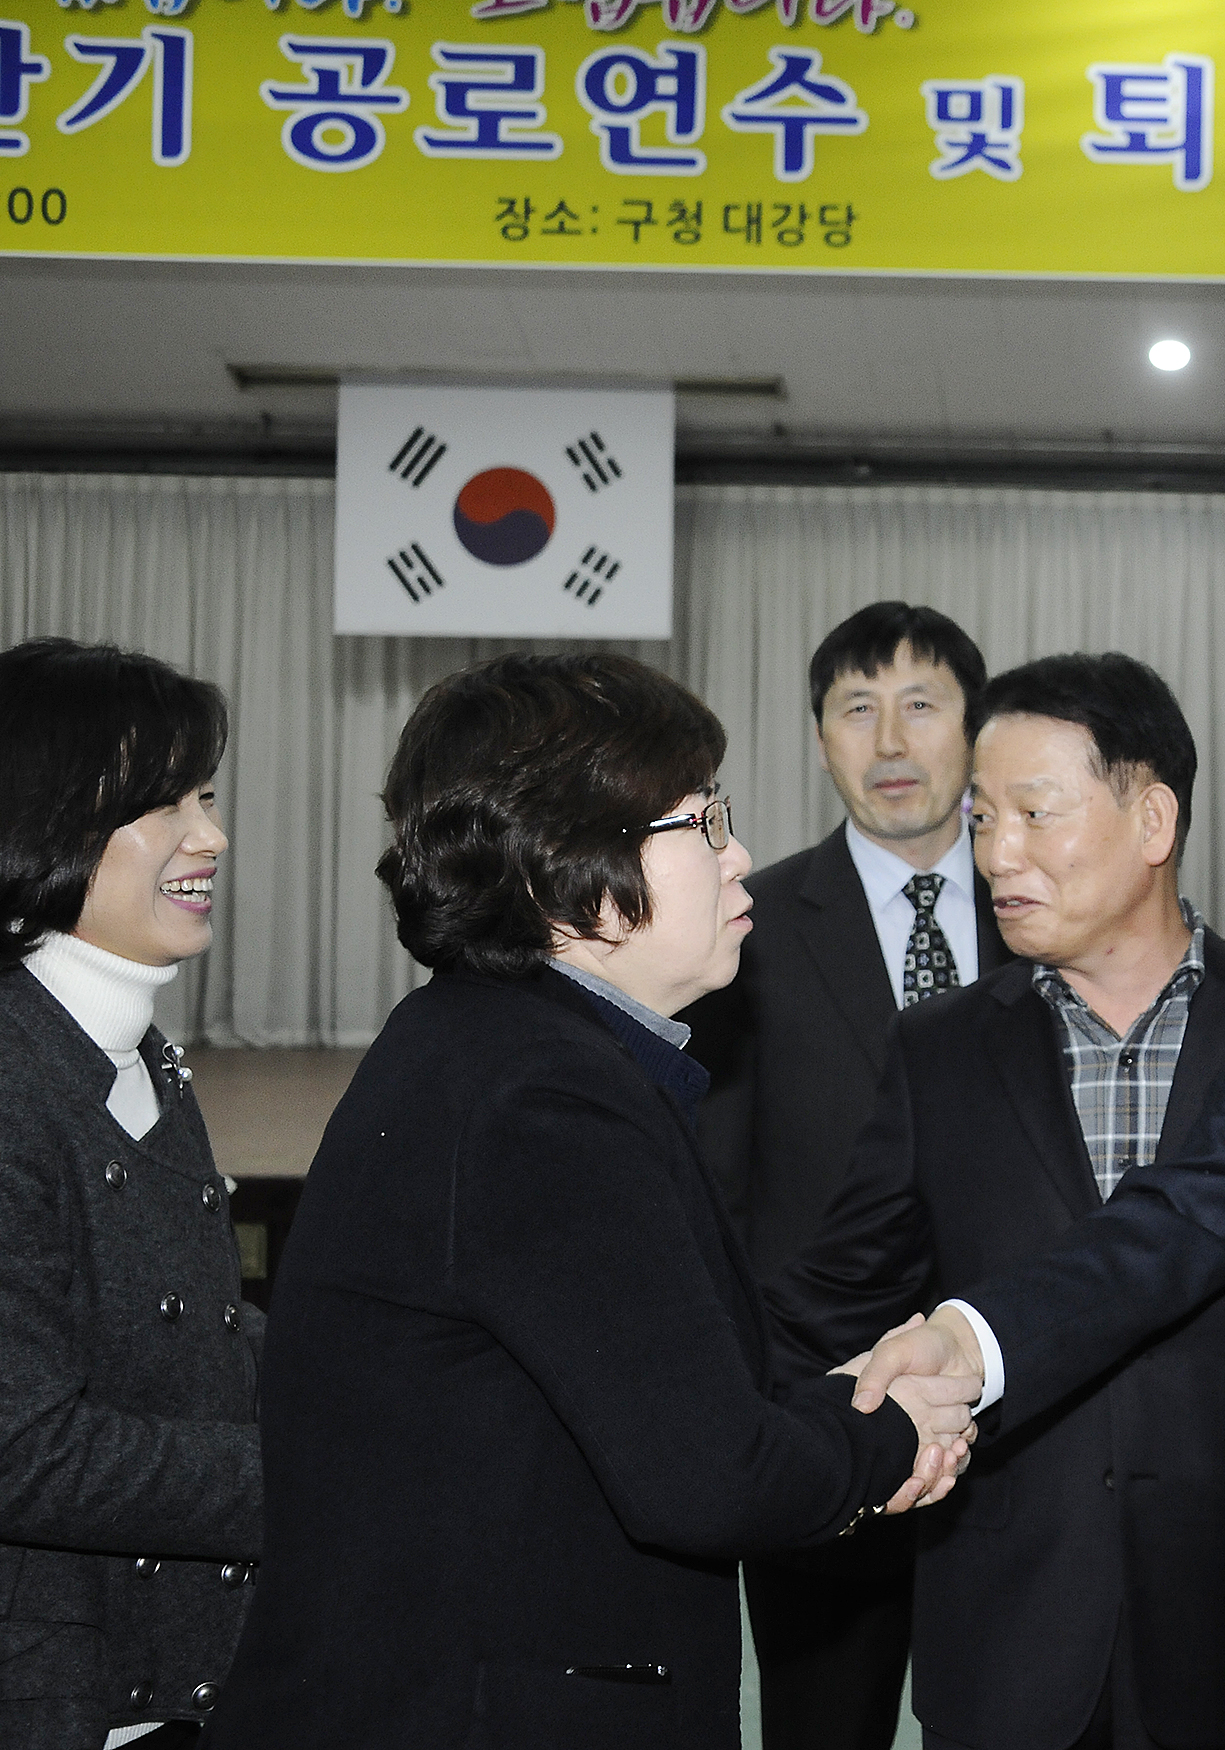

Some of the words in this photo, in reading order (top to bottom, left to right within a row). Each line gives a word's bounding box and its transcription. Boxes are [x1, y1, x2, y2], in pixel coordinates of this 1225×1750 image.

[259, 36, 867, 181] 공로연수
[922, 77, 1025, 182] 및
[494, 197, 599, 242] 장소:
[616, 199, 703, 245] 구청
[722, 201, 858, 248] 대강당
